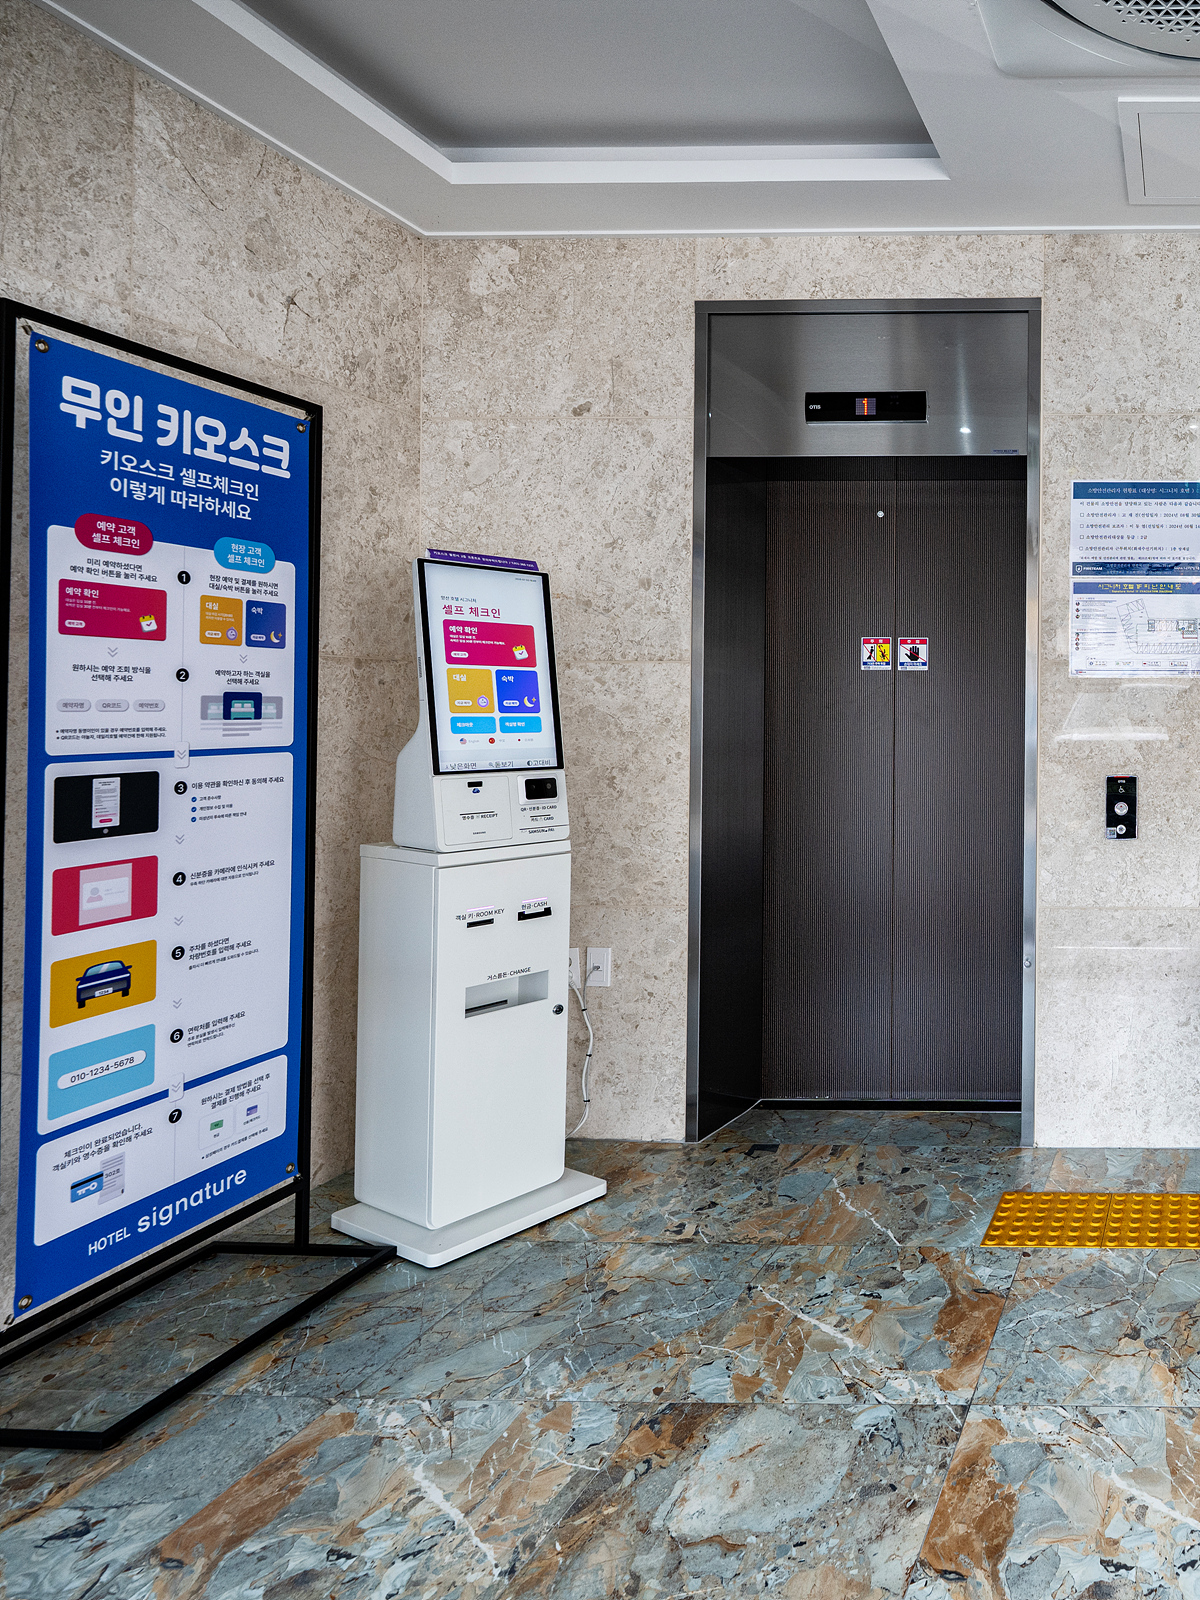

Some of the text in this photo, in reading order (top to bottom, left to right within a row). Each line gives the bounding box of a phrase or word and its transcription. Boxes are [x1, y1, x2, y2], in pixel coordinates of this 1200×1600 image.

[862, 398, 868, 415] 1
[59, 375, 291, 479] 무인 키오스크
[100, 449, 259, 502] 키오스크 셀프체크인
[109, 477, 252, 521] 이렇게 따라하세요
[96, 521, 136, 536] 예약 고객
[92, 532, 140, 549] 셀프 체크인
[231, 543, 262, 556] 현장 고객
[87, 558, 143, 572] 미리 예약하셨다면
[227, 554, 265, 568] 셀프 체크인
[70, 565, 158, 582] 예약 확인 버튼을 눌러 주세요
[209, 574, 221, 582] 현장
[65, 587, 99, 598] 예약 확인
[235, 585, 250, 594] 버튼을
[263, 589, 278, 597] 주세요
[206, 602, 219, 611] 대실
[251, 607, 263, 615] 숙박
[442, 605, 500, 618] 셀프 체크인
[72, 664, 151, 674] 원하시는 예약 조회 방식을
[243, 670, 253, 678] 하는
[452, 674, 467, 682] 대실
[450, 762, 477, 770] 낮은화면
[191, 781, 203, 789] 이용
[205, 780, 221, 789] 약관을
[190, 870, 213, 880] 신분증을
[214, 866, 236, 875] 카메라에
[259, 859, 275, 867] 주세요
[188, 940, 252, 960] 차량번호를 입력해 주세요
[189, 942, 206, 952] 주차를
[187, 1011, 246, 1035] 연락처를 입력해 주세요
[70, 1056, 135, 1083] 010-1234-5678
[246, 1084, 261, 1095] 주세요
[64, 1123, 143, 1158] 체크인이 완료되었습니다.
[52, 1128, 153, 1171] 객실키와 영수증을 확인해 주세요
[88, 1169, 248, 1256] HOTEL signature
